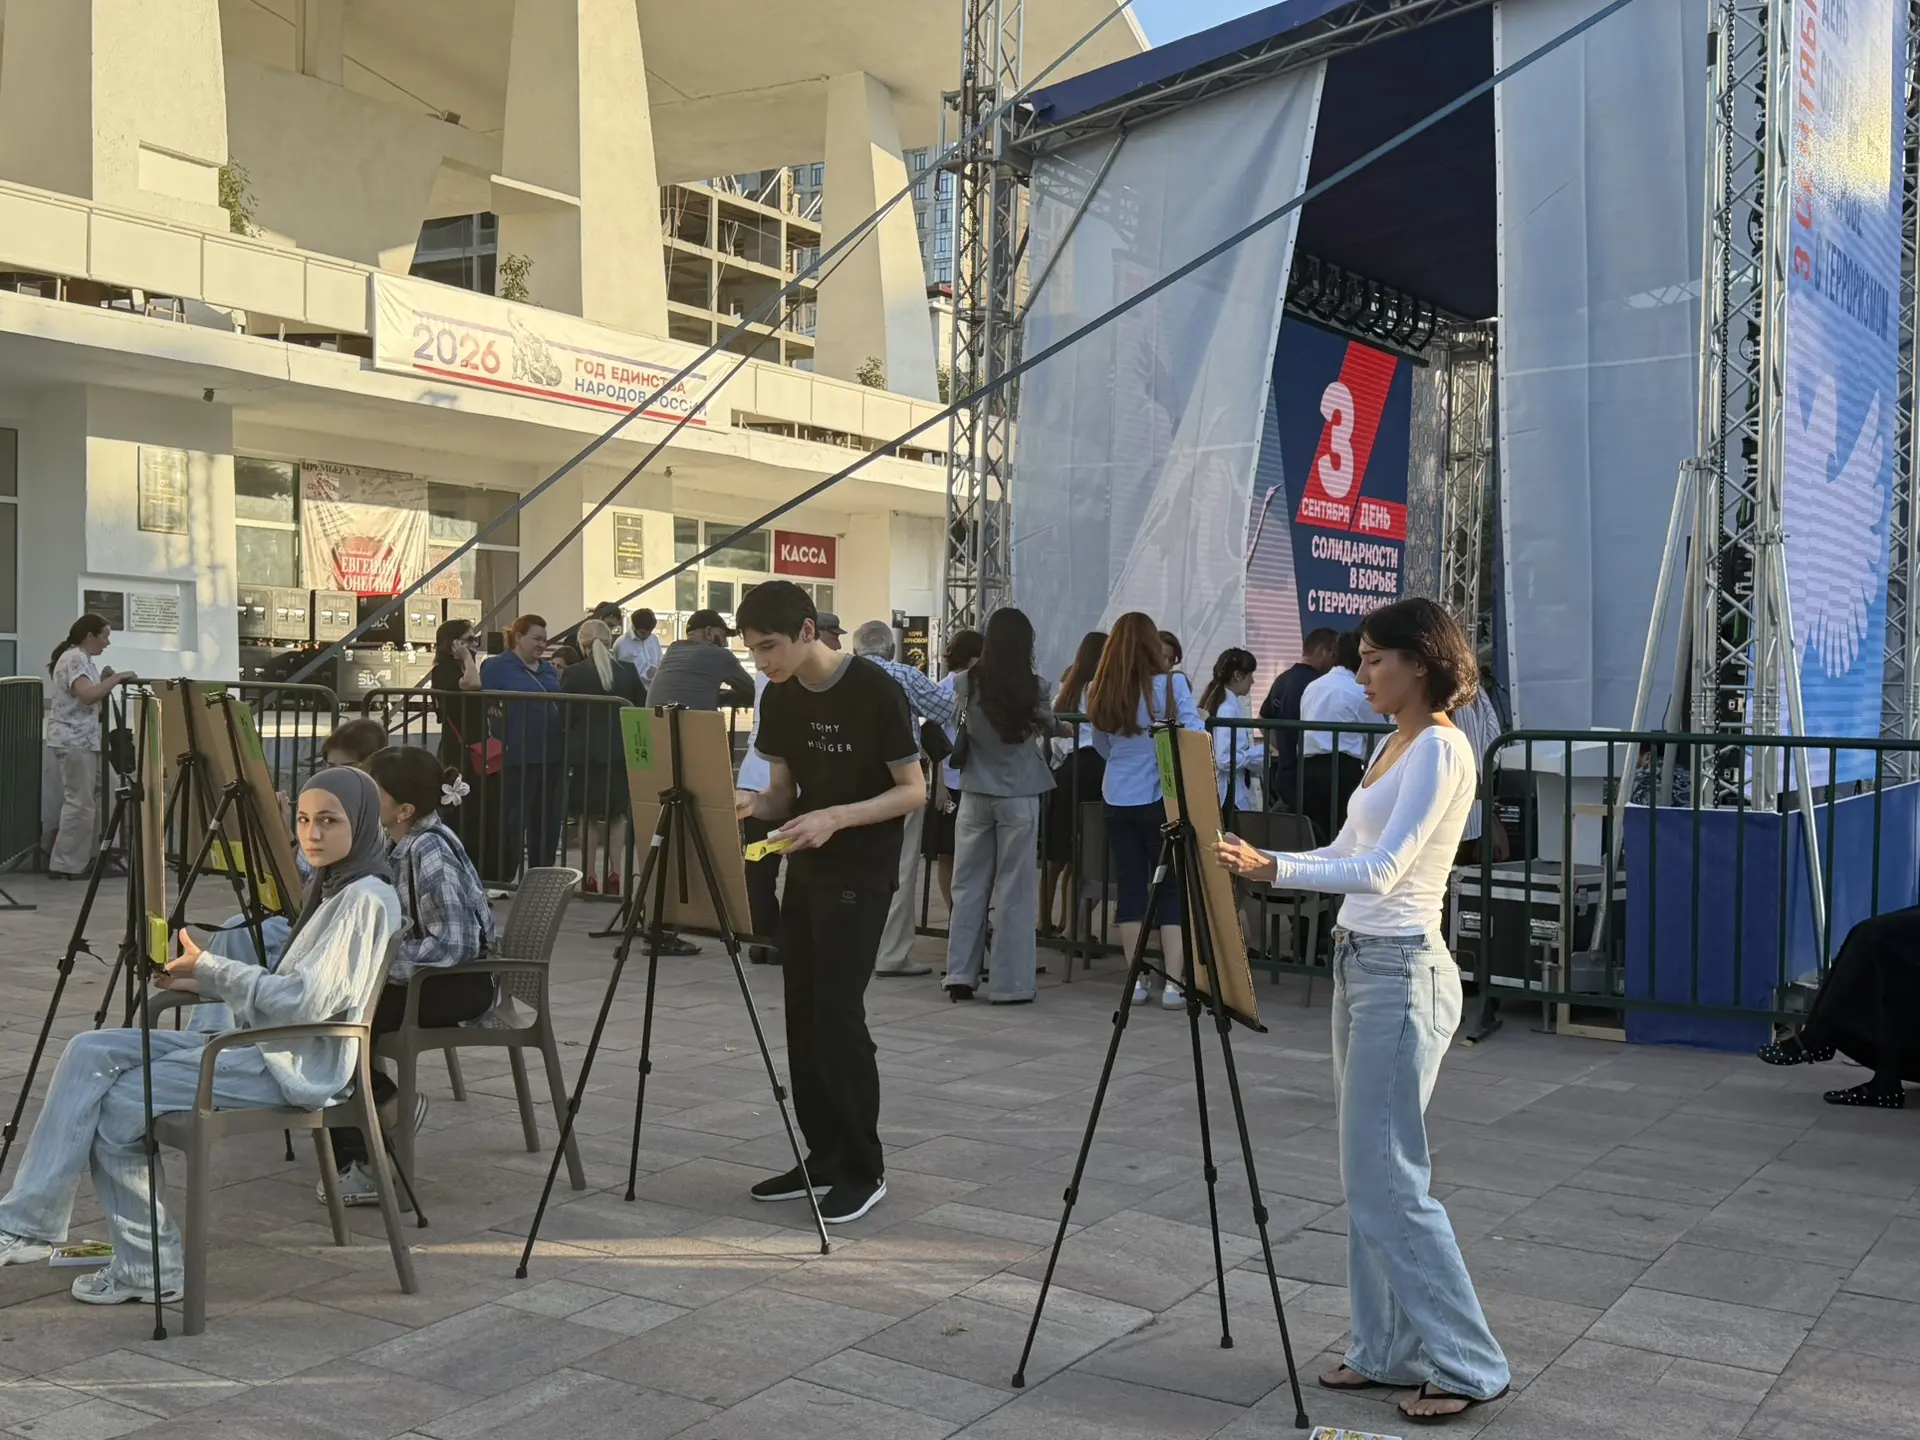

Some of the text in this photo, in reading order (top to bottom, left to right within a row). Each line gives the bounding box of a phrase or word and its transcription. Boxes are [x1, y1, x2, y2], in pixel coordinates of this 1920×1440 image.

[1794, 246, 1811, 281] 3
[413, 323, 500, 374] 2026
[575, 358, 606, 380] ГОД
[575, 378, 646, 403] НАРОДОВ
[1317, 381, 1355, 499] 3
[1301, 497, 1350, 524] СЕНТЯБРЯ
[1359, 502, 1391, 531] ДЕНЬ
[781, 544, 827, 564] КАССА
[1311, 535, 1399, 569] СОЛИДАРНОСТИ
[1349, 567, 1398, 593] В БОРЬБЕ
[1307, 589, 1316, 612] С
